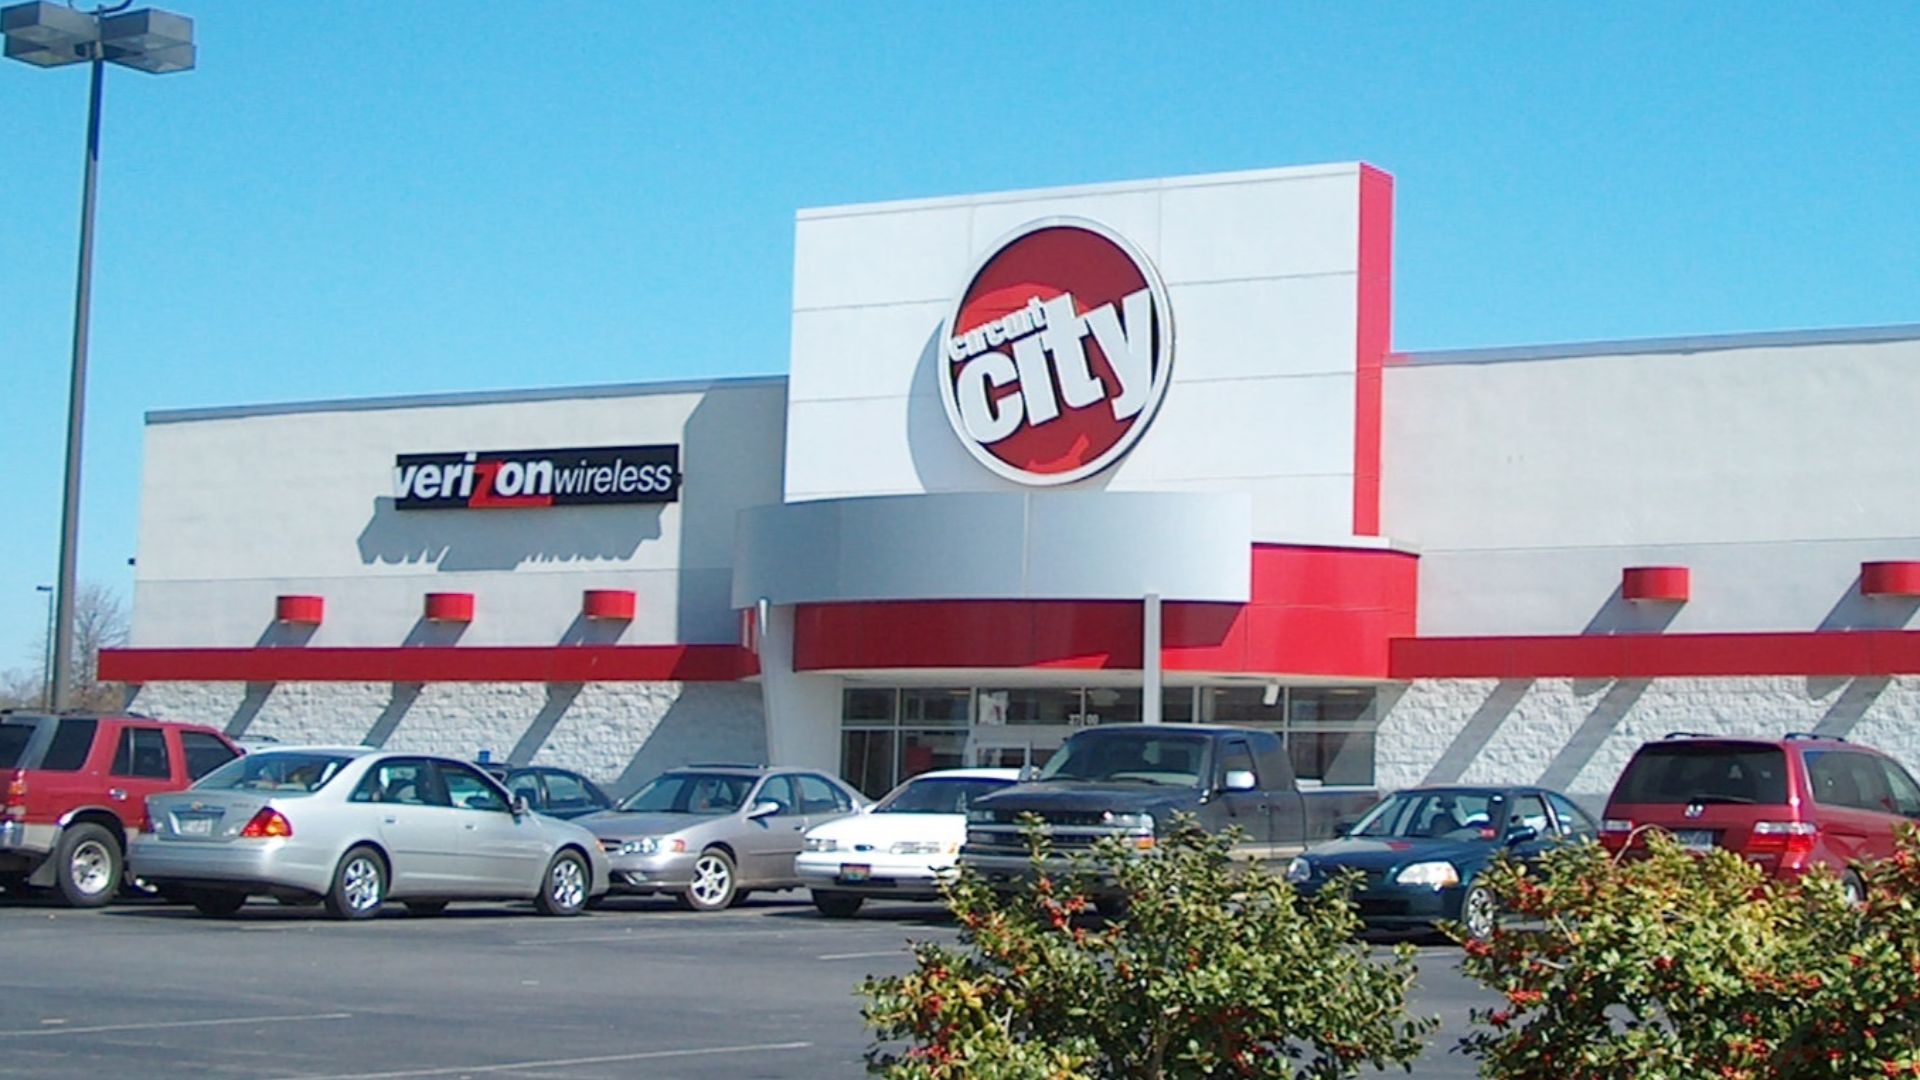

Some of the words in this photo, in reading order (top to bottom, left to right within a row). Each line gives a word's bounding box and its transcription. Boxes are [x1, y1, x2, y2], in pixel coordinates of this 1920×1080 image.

[950, 295, 1048, 361] circuit
[957, 287, 1151, 443] city
[392, 452, 554, 508] verizon
[555, 459, 673, 493] wireless
